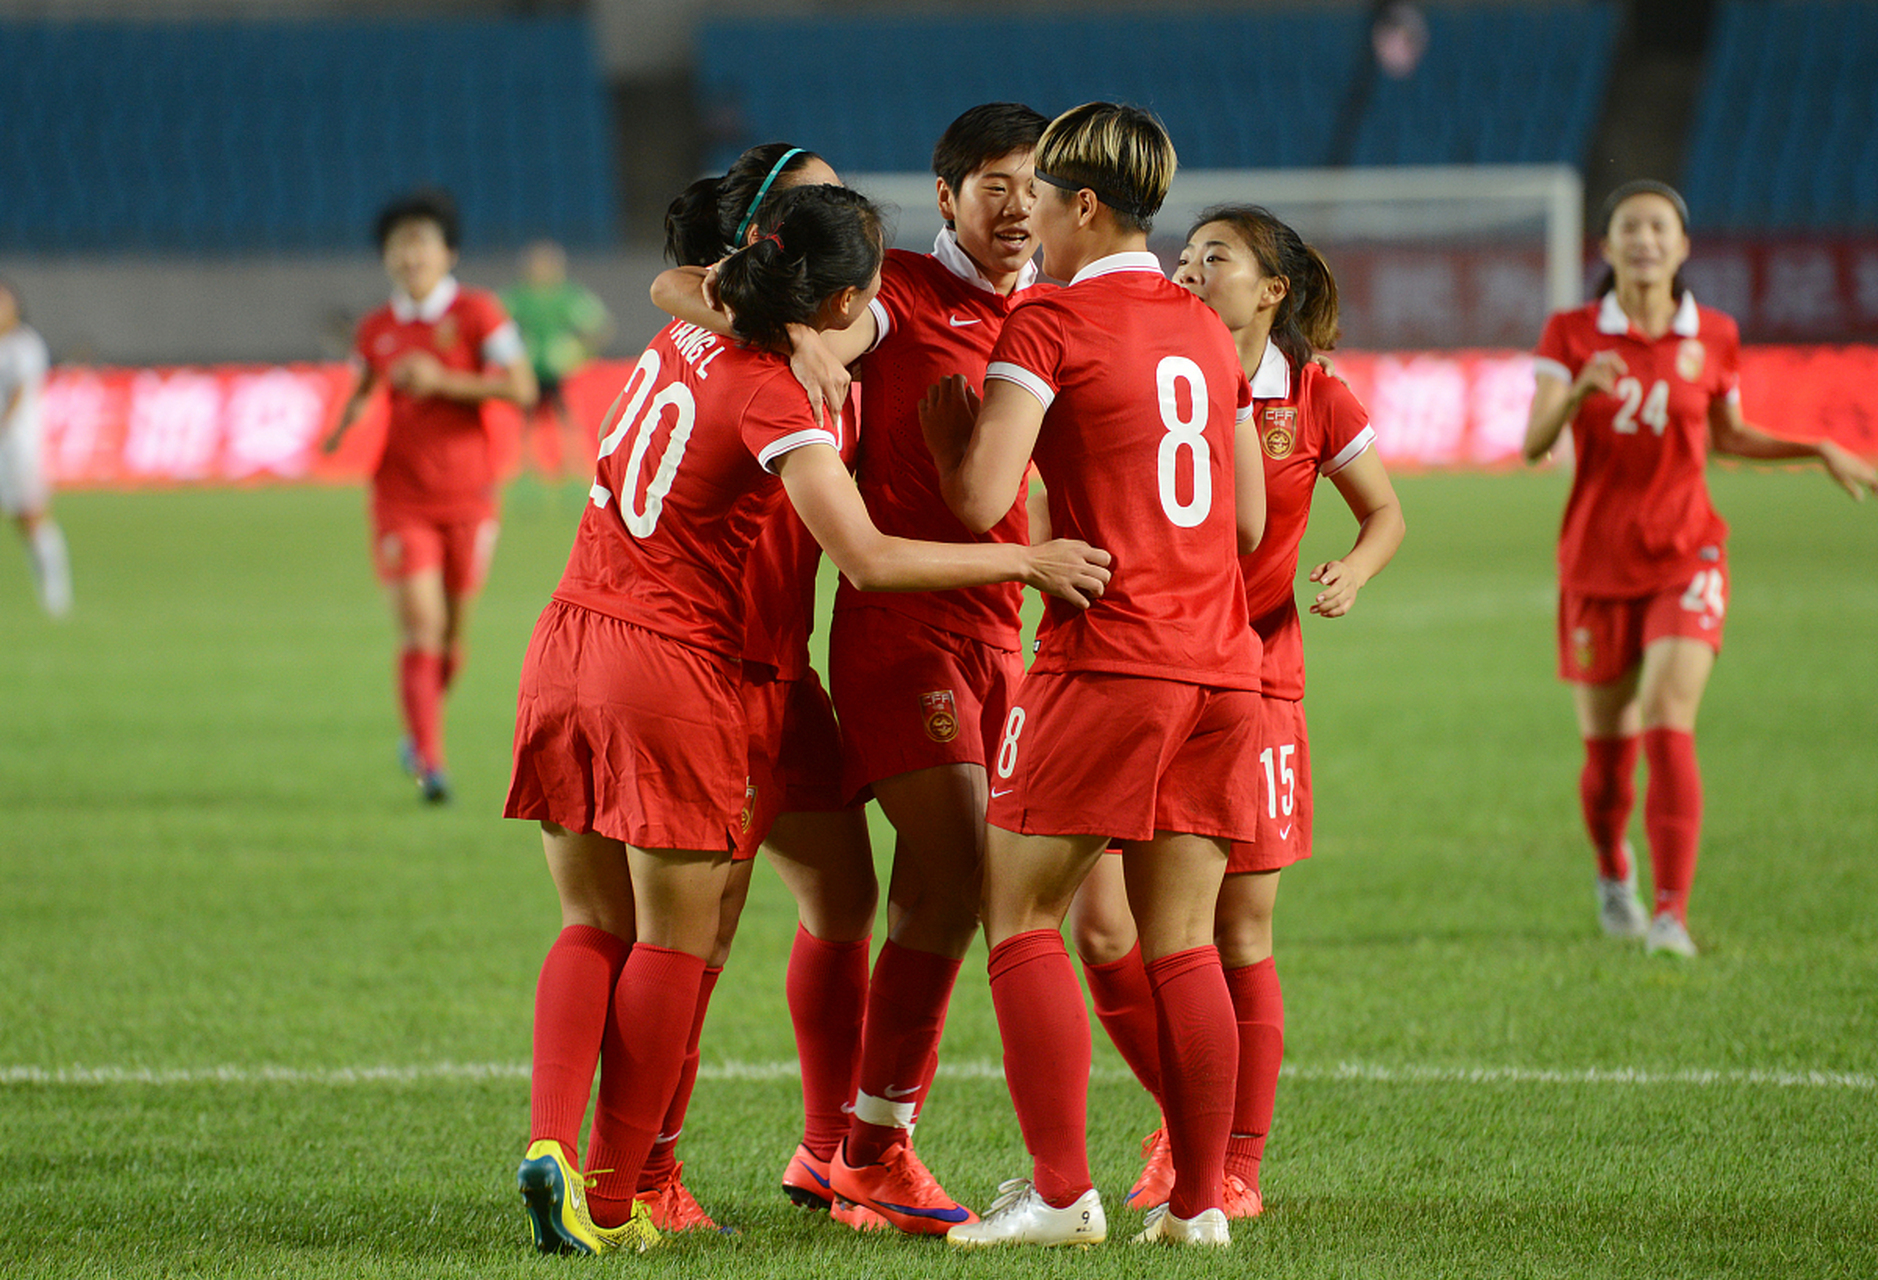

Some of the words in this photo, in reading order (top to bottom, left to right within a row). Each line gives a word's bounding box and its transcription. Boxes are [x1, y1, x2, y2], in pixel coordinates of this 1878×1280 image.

[695, 345, 726, 380] L
[1265, 410, 1295, 420] CFA
[1612, 376, 1669, 437] 24
[589, 348, 696, 538] 20
[1156, 355, 1212, 528] 8
[998, 706, 1026, 779] 8
[1260, 744, 1295, 819] 15
[1082, 1210, 1090, 1225] 9
